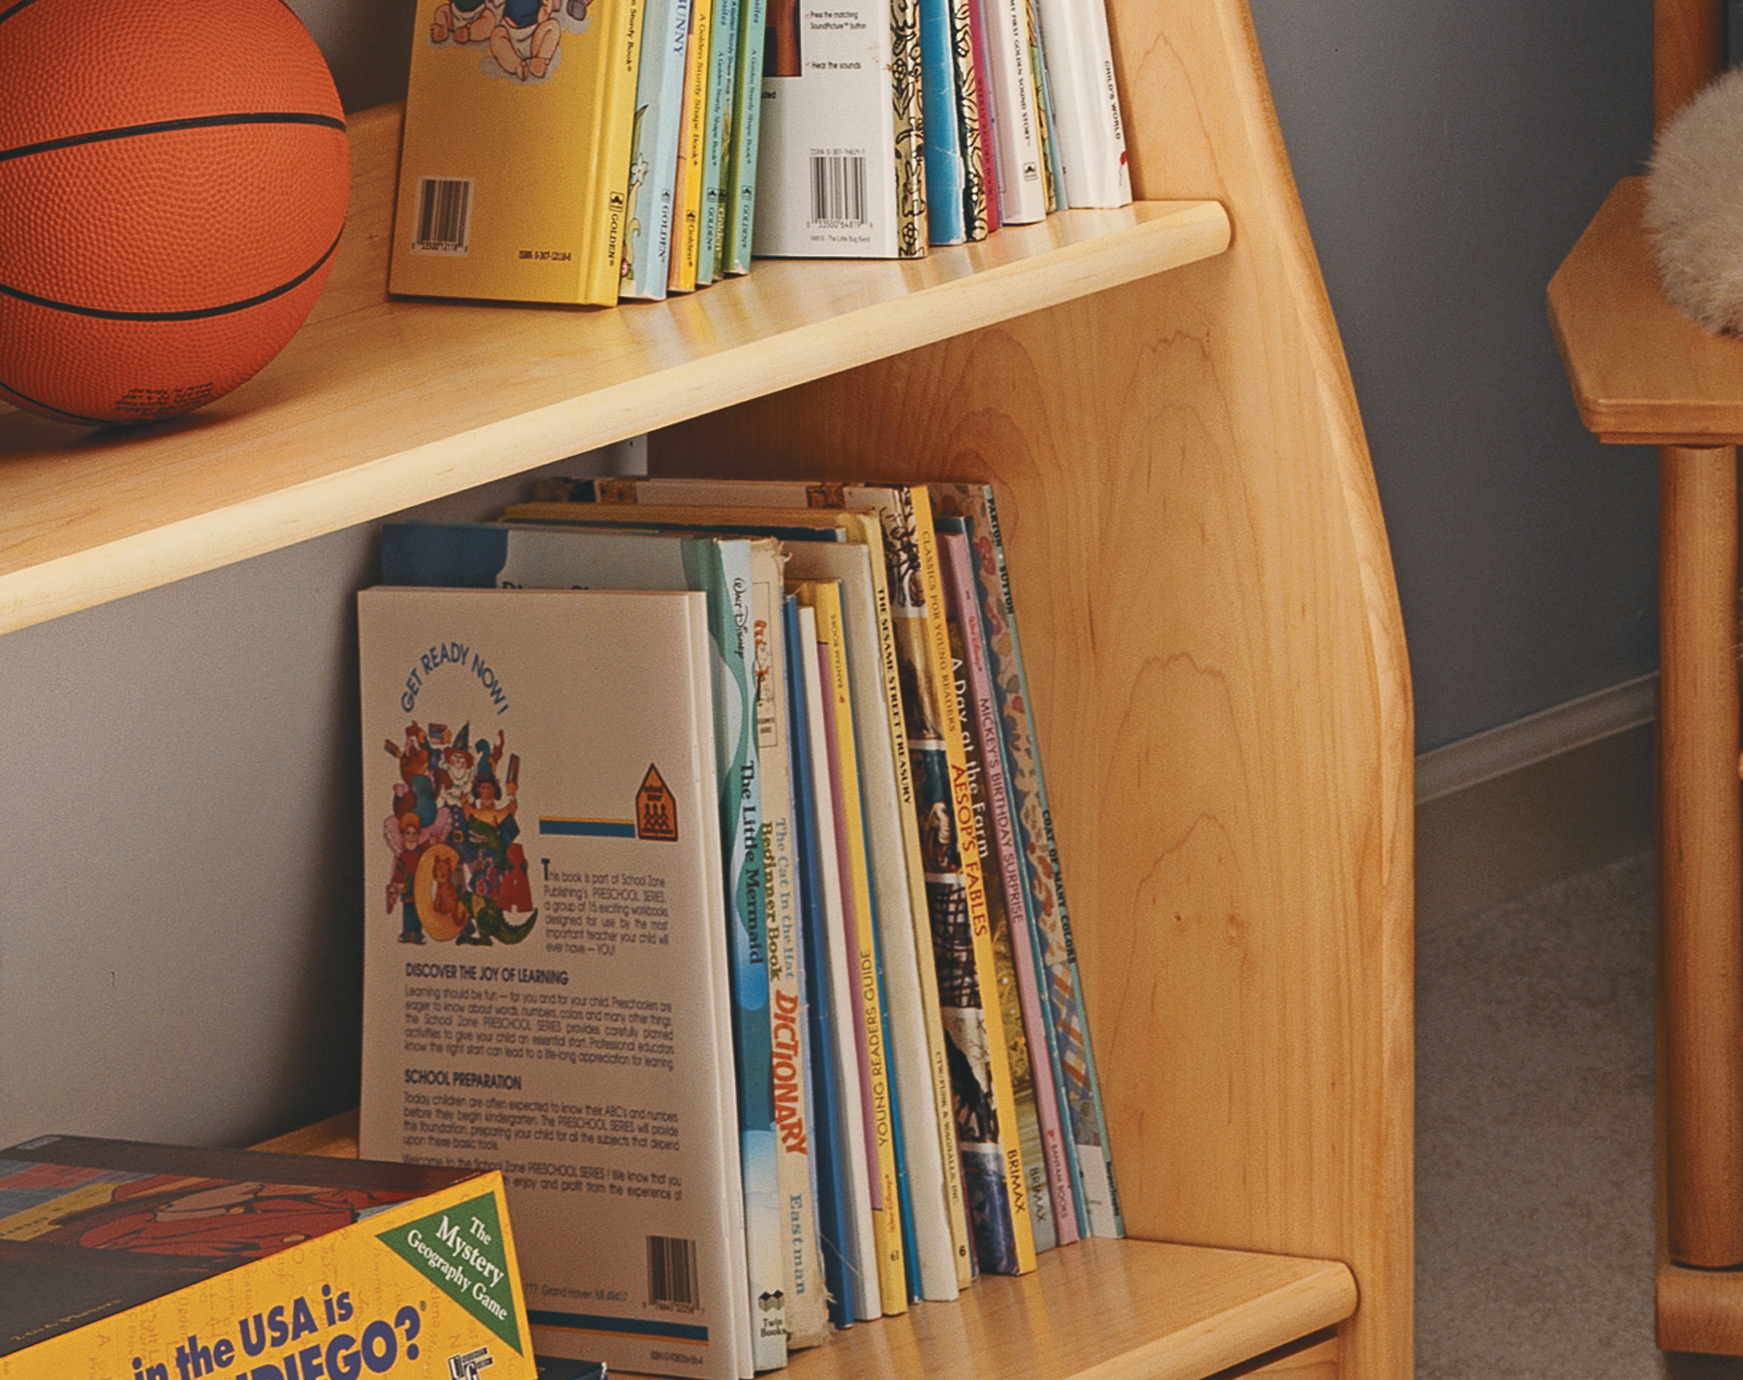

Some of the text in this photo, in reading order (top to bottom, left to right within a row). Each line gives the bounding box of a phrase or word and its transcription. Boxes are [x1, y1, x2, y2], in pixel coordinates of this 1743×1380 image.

[1101, 59, 1124, 140] CHILD'S WORLD
[401, 668, 423, 713] GET
[421, 641, 470, 675] READY
[876, 588, 911, 804] THE SESAME STREET TREASURY
[949, 656, 992, 858] A Day at the Farm
[951, 762, 987, 937] AESOP'S FABLES
[978, 696, 1023, 923] MICKEY'S BIRTHDAY SURPRISE
[739, 760, 764, 964] The Little Mermaid
[759, 821, 782, 981] Beginner Book
[405, 1069, 522, 1091] SCHOOL PREPARATION
[770, 988, 808, 1157] DICTIONARY
[859, 950, 889, 1147] YOUNG READERS GUIDE
[1006, 1148, 1025, 1213] BRIMAX
[1027, 1166, 1047, 1221] BRIMAX
[407, 1228, 508, 1322] Geography Game
[435, 1214, 506, 1289] Mystery
[469, 1215, 492, 1246] The
[788, 1192, 809, 1294] Eastman
[239, 1295, 319, 1358] USA
[320, 1283, 354, 1326] is
